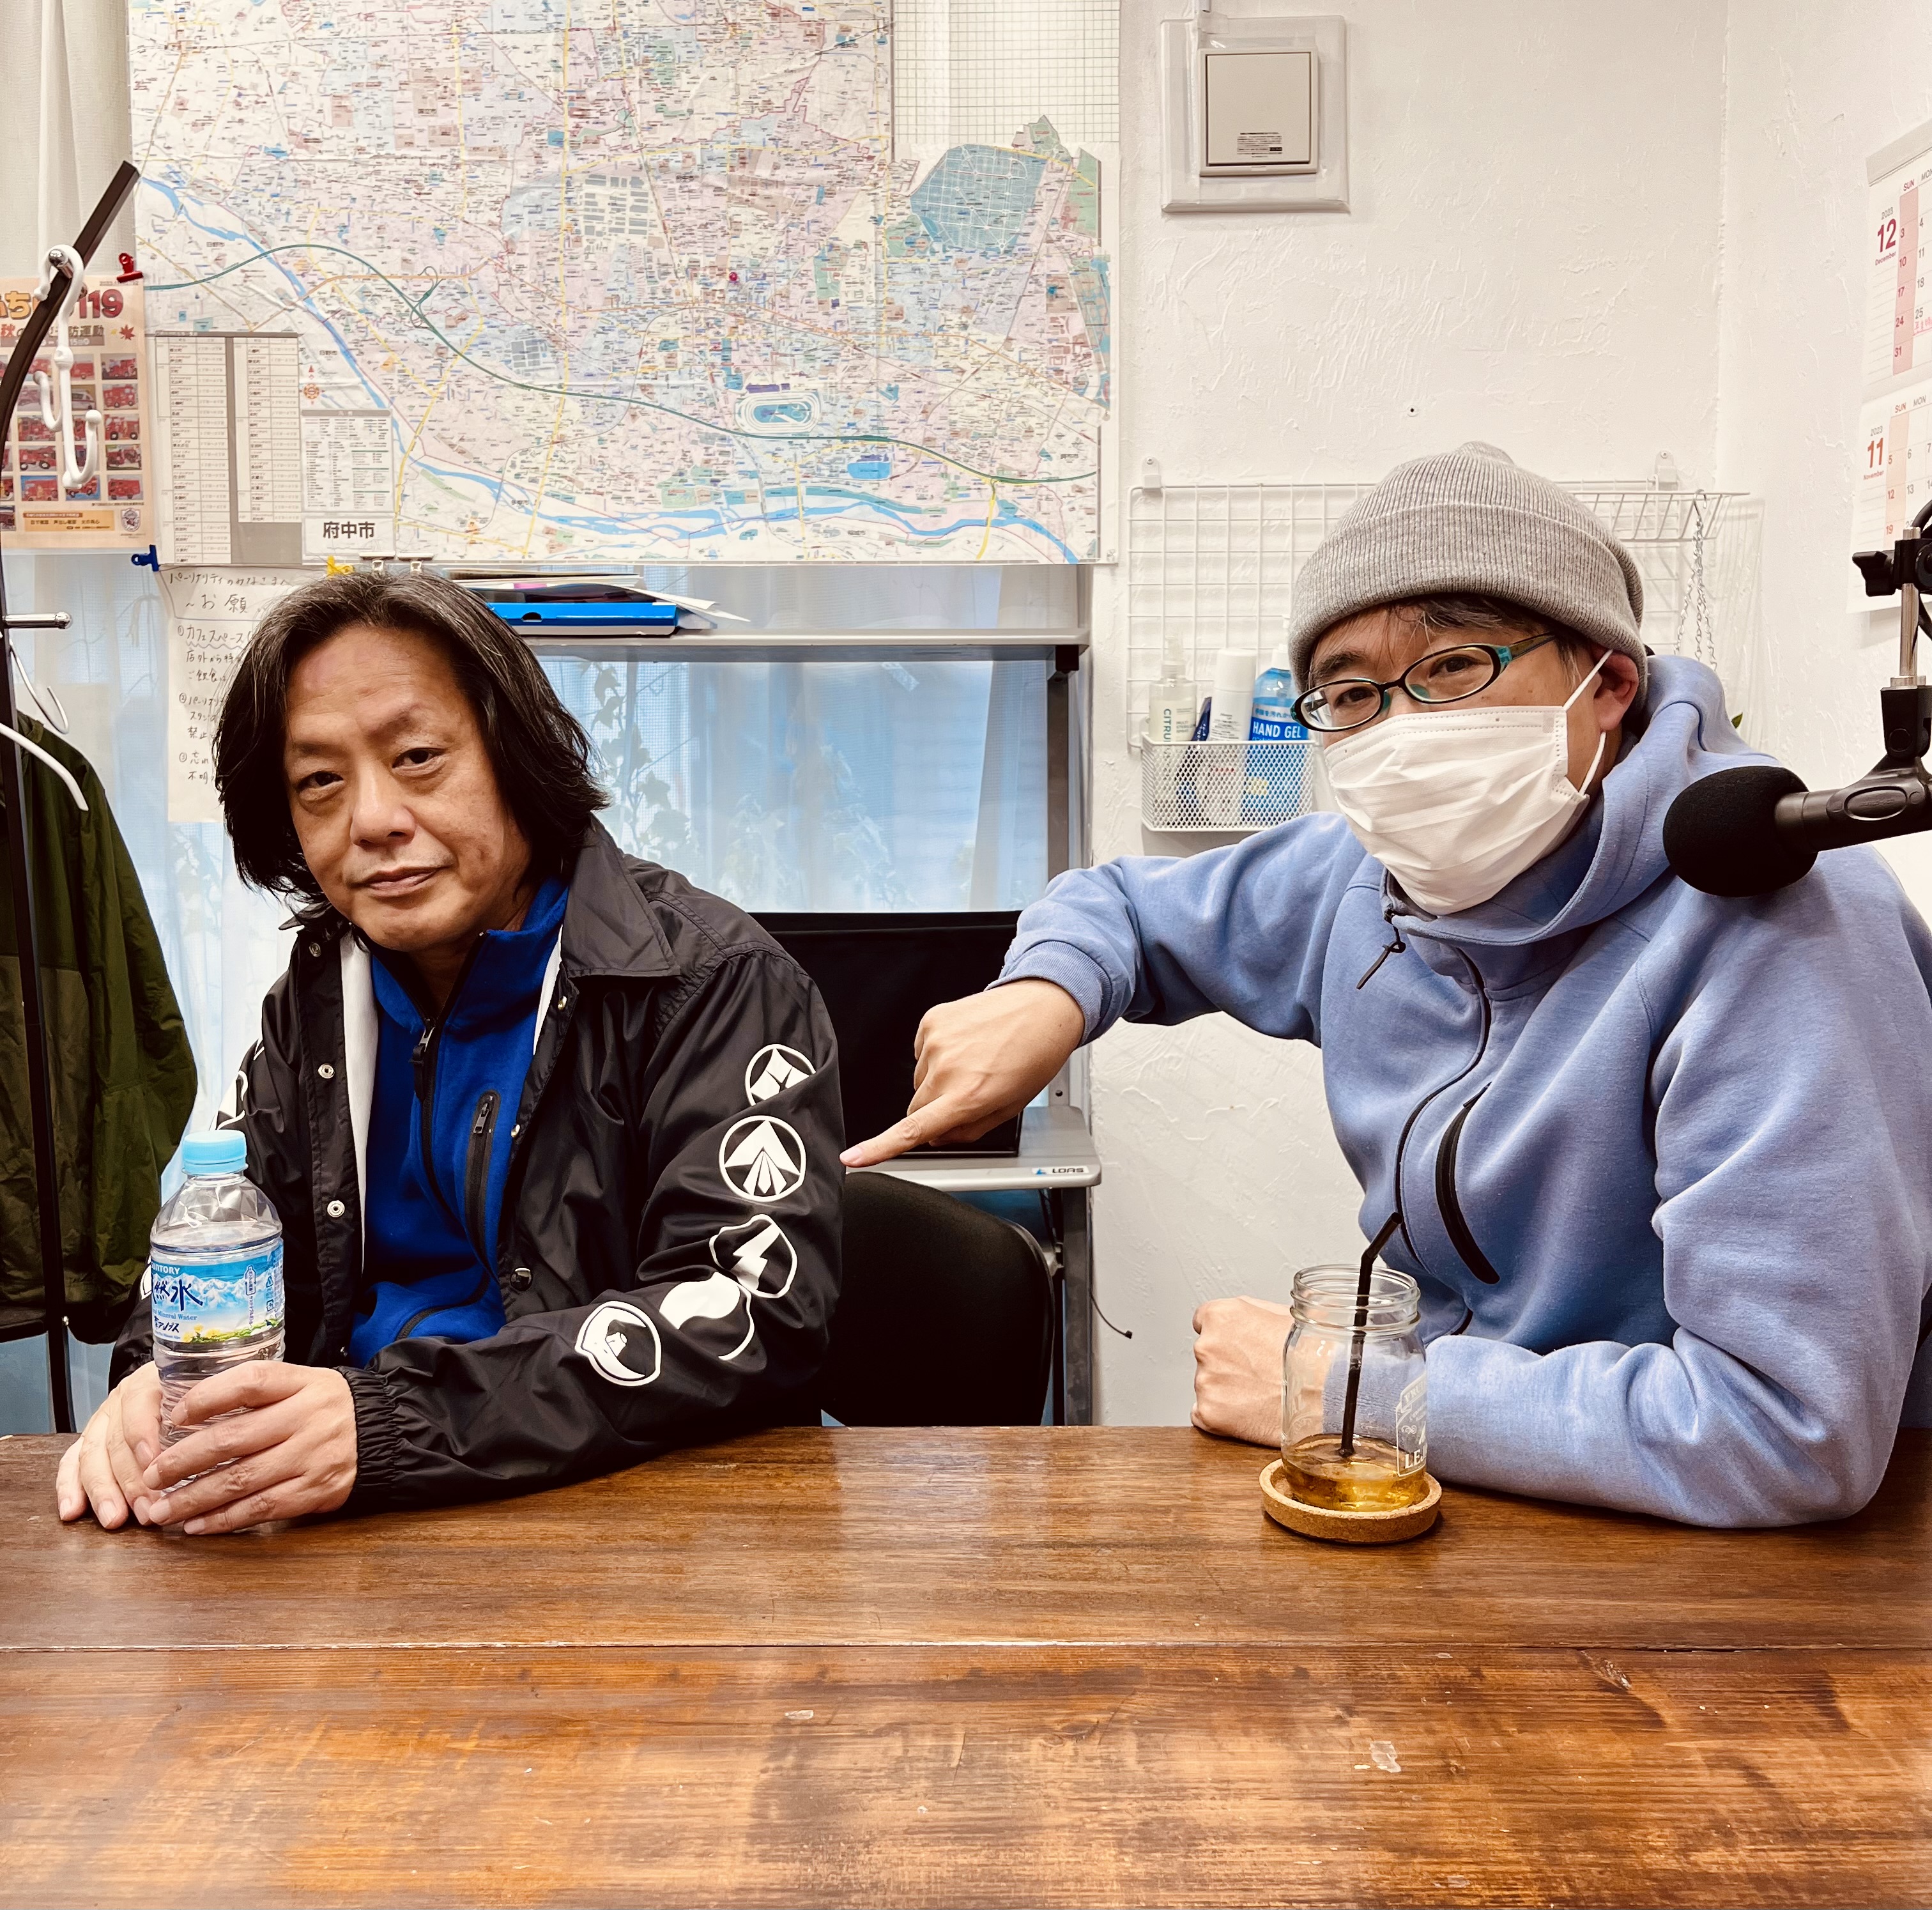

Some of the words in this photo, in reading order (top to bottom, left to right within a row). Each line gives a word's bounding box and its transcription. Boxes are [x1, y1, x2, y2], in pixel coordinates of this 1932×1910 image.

[1903, 179, 1915, 191] SUN
[1881, 207, 1894, 220] 2023
[1877, 219, 1897, 252] 12
[1900, 227, 1905, 238] 3
[1919, 217, 1924, 227] 4
[1874, 251, 1896, 266] December
[1899, 256, 1907, 268] 10
[1919, 247, 1925, 258] 11
[1897, 286, 1905, 298] 17
[1917, 277, 1924, 288] 18
[1895, 316, 1905, 327] 24
[1915, 307, 1924, 320] 25
[1894, 346, 1902, 357] 31
[1894, 403, 1906, 413] SUN
[1913, 395, 1926, 407] MON
[1870, 426, 1883, 436] 2023
[1867, 437, 1883, 468] 11
[1888, 455, 1892, 465] 5
[1907, 449, 1912, 459] 6
[1927, 443, 1931, 453] 7
[1887, 489, 1895, 500] 12
[1906, 484, 1914, 495] 13
[323, 521, 376, 539] 府中市
[1886, 525, 1894, 535] 19
[1163, 709, 1172, 742] CITRU
[1252, 721, 1280, 737] HAND
[1284, 726, 1301, 738] GEL
[151, 1273, 204, 1312] 然水
